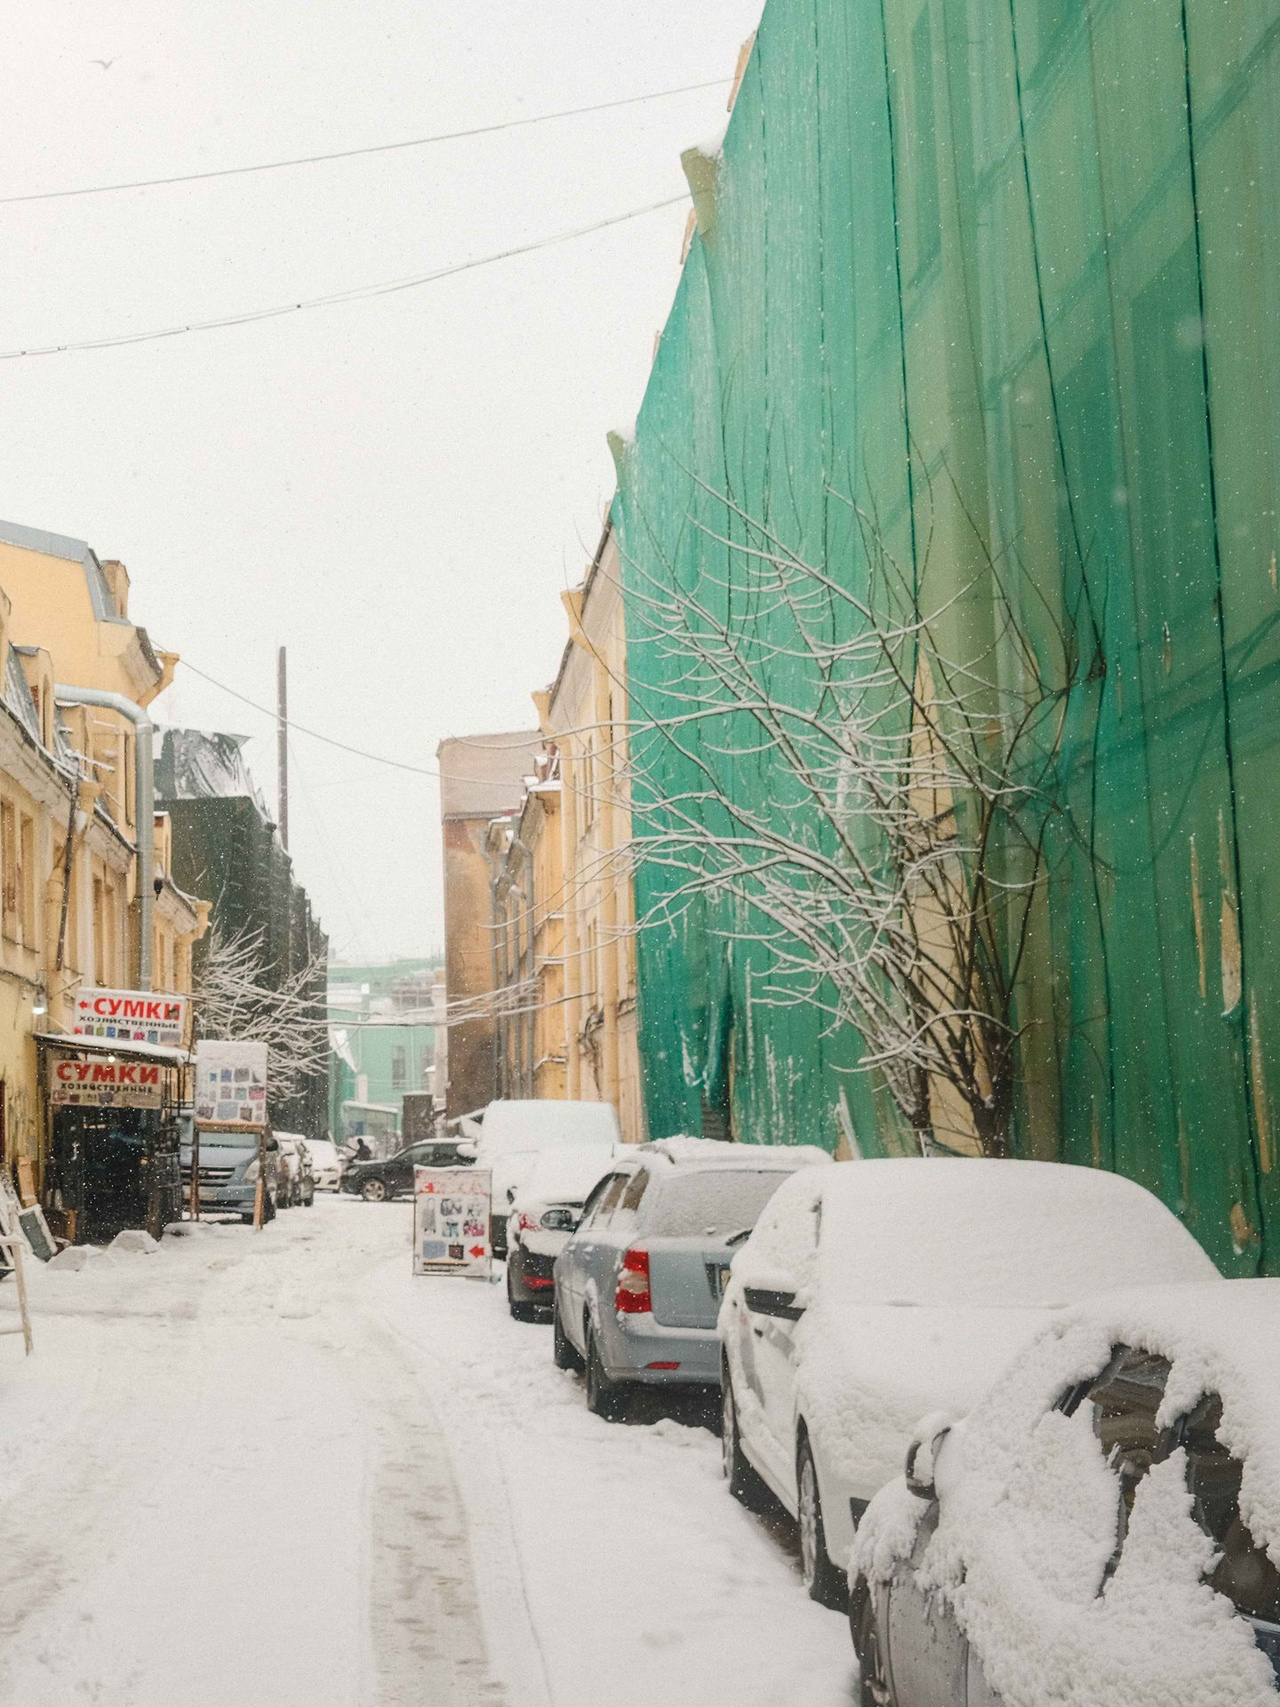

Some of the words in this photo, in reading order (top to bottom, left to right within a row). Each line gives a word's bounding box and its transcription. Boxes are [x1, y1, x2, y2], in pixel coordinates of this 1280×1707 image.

[94, 997, 180, 1021] СУМКИ
[79, 1015, 179, 1029] ХОЗЯЙСТВЕННЫЕ
[56, 1062, 160, 1085] СУМКИ
[61, 1082, 153, 1094] ХОЗЯЙСТВЕННЫЕ
